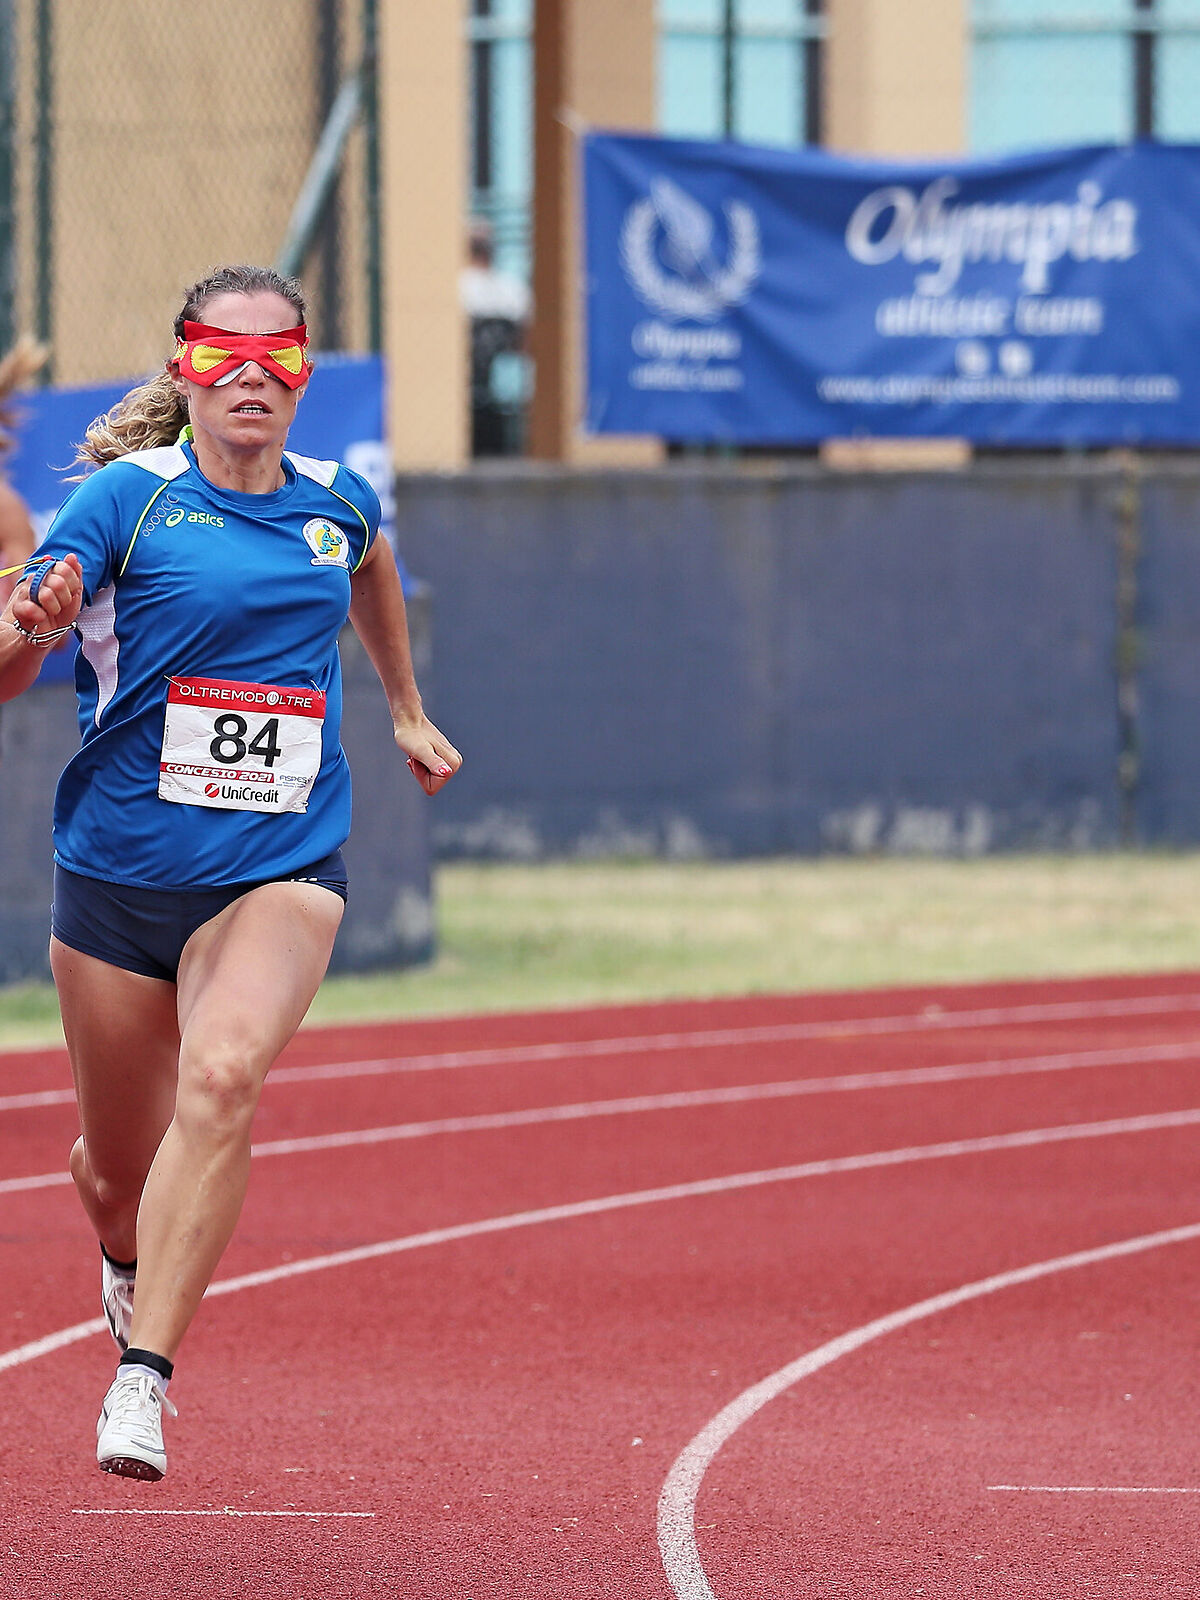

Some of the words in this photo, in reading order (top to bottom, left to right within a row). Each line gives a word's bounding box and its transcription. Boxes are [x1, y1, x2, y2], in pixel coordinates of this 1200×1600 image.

[845, 176, 1138, 295] Olympia
[187, 512, 225, 528] asics
[179, 685, 313, 709] OLTREMODOLTRE
[209, 713, 282, 768] 84
[166, 763, 237, 780] CONCESIO
[238, 771, 273, 783] 2021
[221, 785, 279, 803] UniCredit
